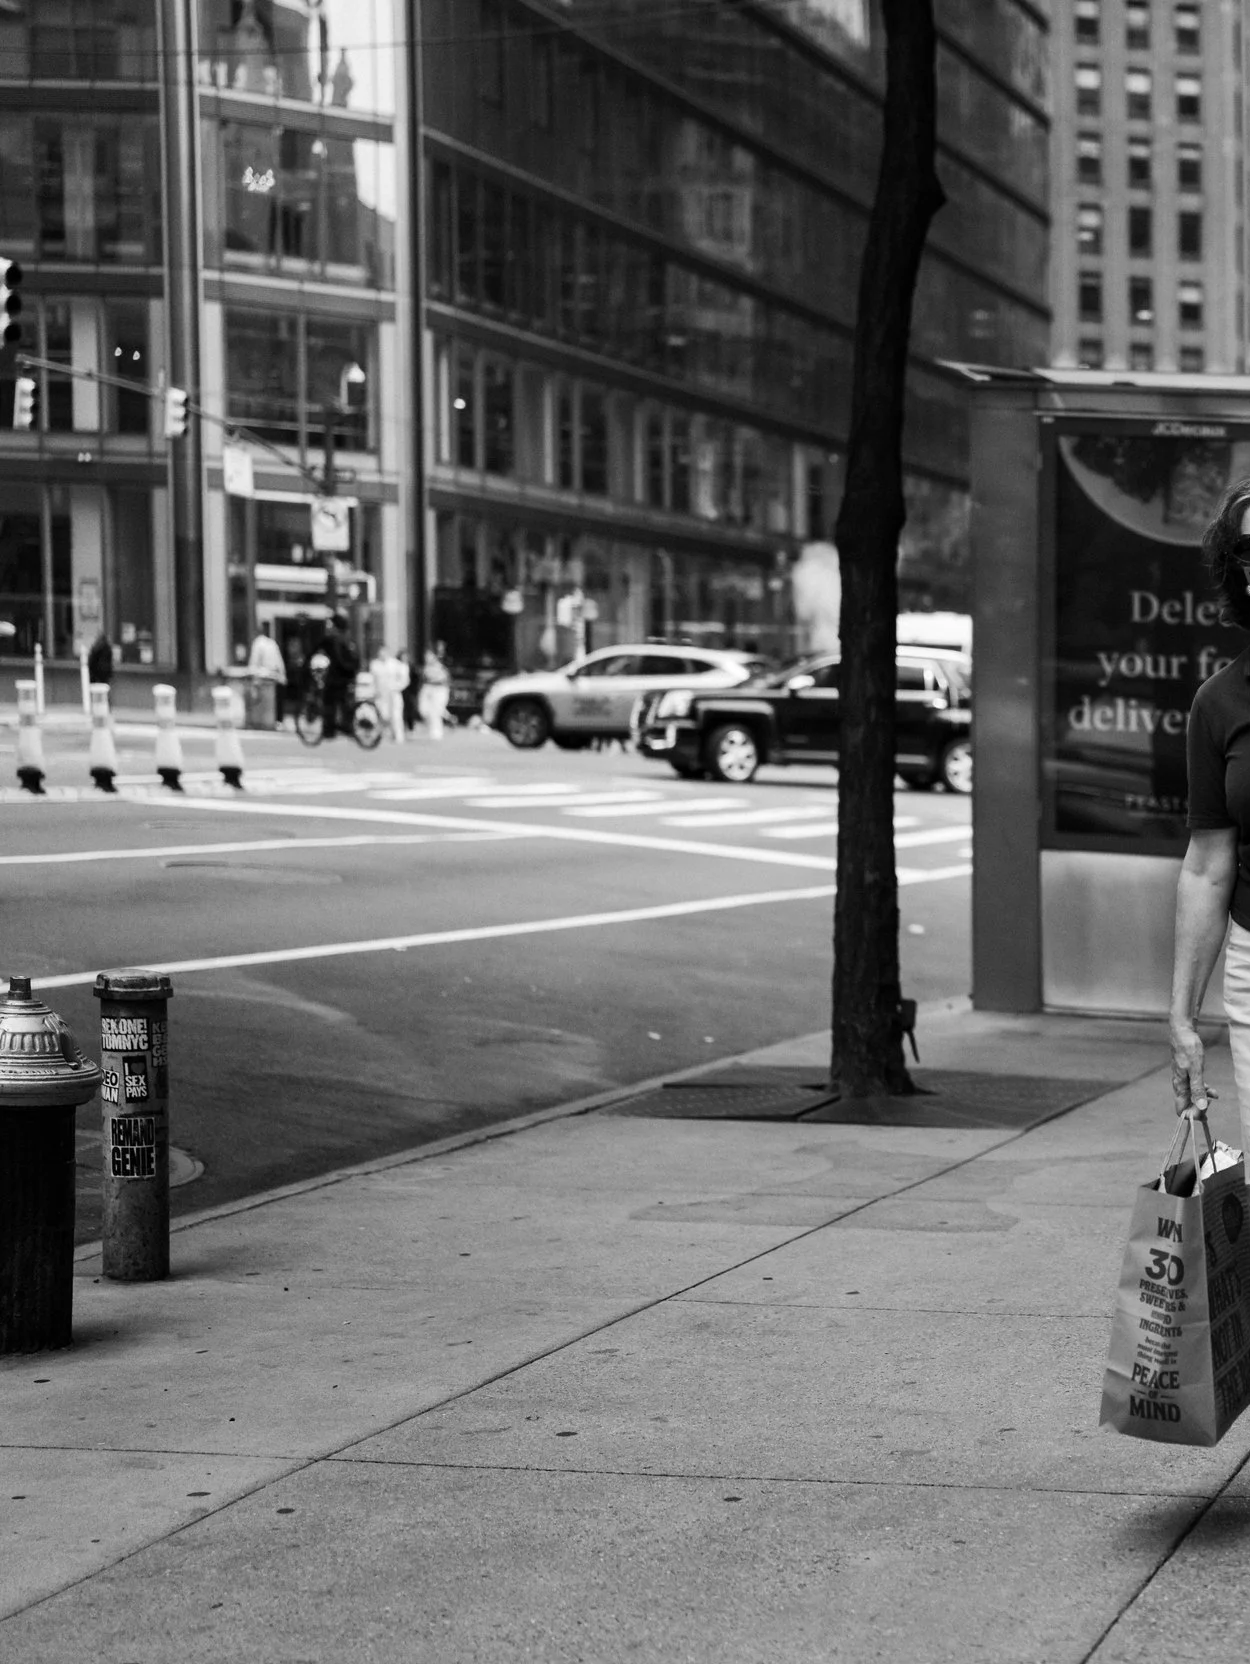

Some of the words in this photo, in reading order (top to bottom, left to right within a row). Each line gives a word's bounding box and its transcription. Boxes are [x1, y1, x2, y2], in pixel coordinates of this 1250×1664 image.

[1096, 650, 1187, 686] your
[1068, 695, 1190, 734] delive
[125, 1075, 146, 1086] SEX
[126, 1086, 147, 1098] PAYS
[112, 1146, 155, 1176] GENIE
[1131, 1362, 1180, 1389] PEACE
[1129, 1395, 1181, 1422] MIND
